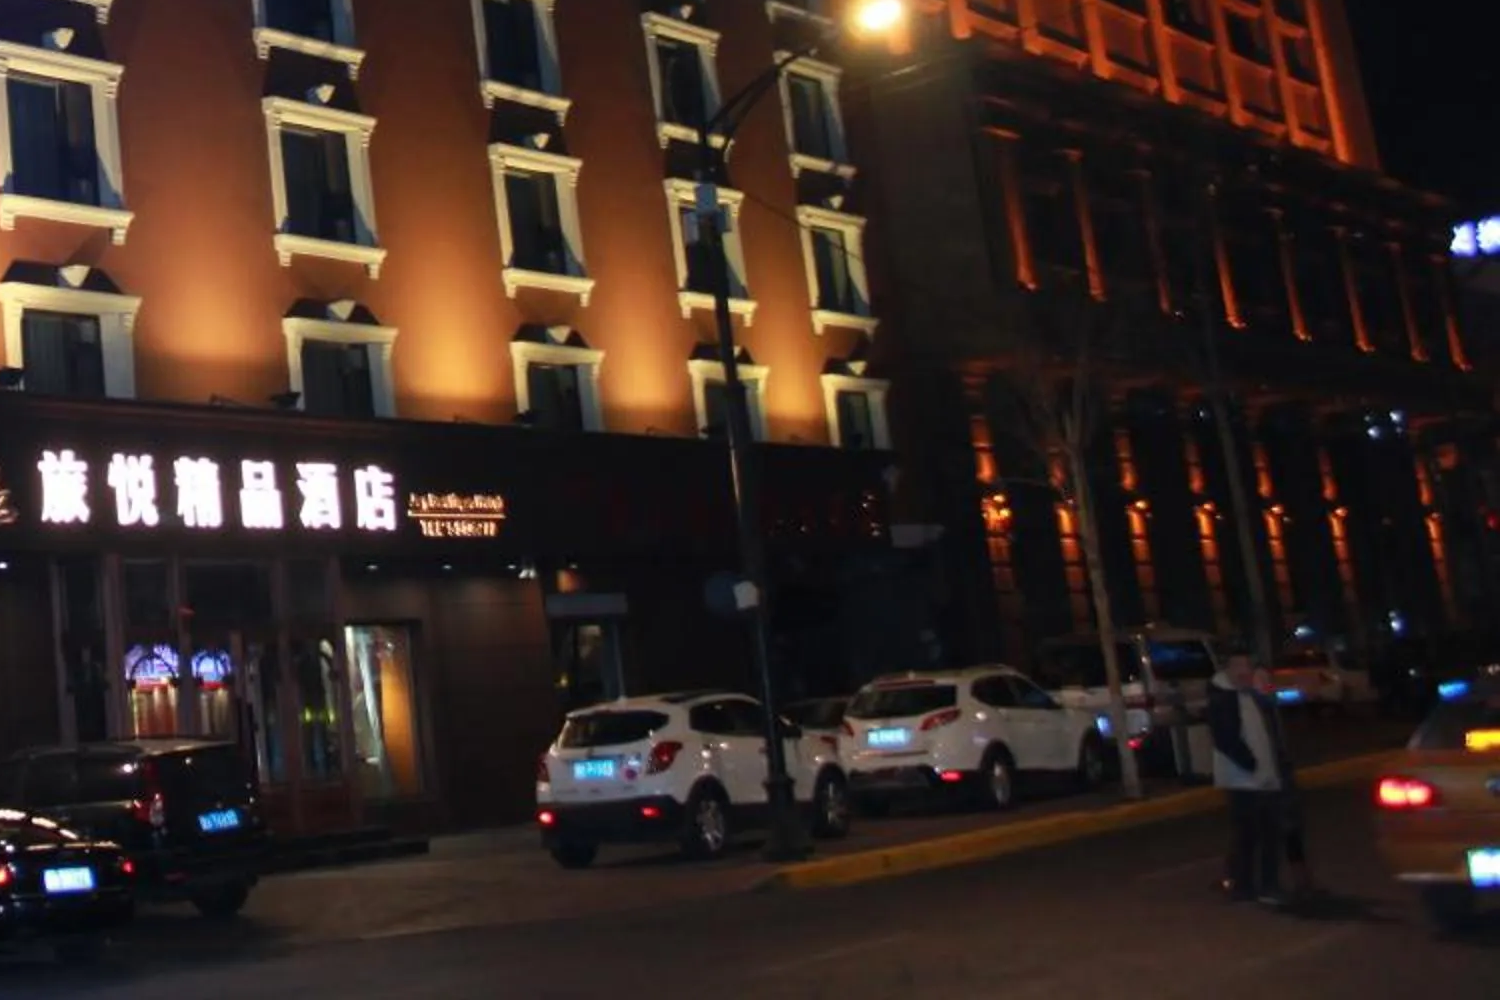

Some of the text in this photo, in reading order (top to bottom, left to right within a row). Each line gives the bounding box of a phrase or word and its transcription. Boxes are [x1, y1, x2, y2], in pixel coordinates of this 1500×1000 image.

[37, 448, 397, 532] 旅悦精品酒店
